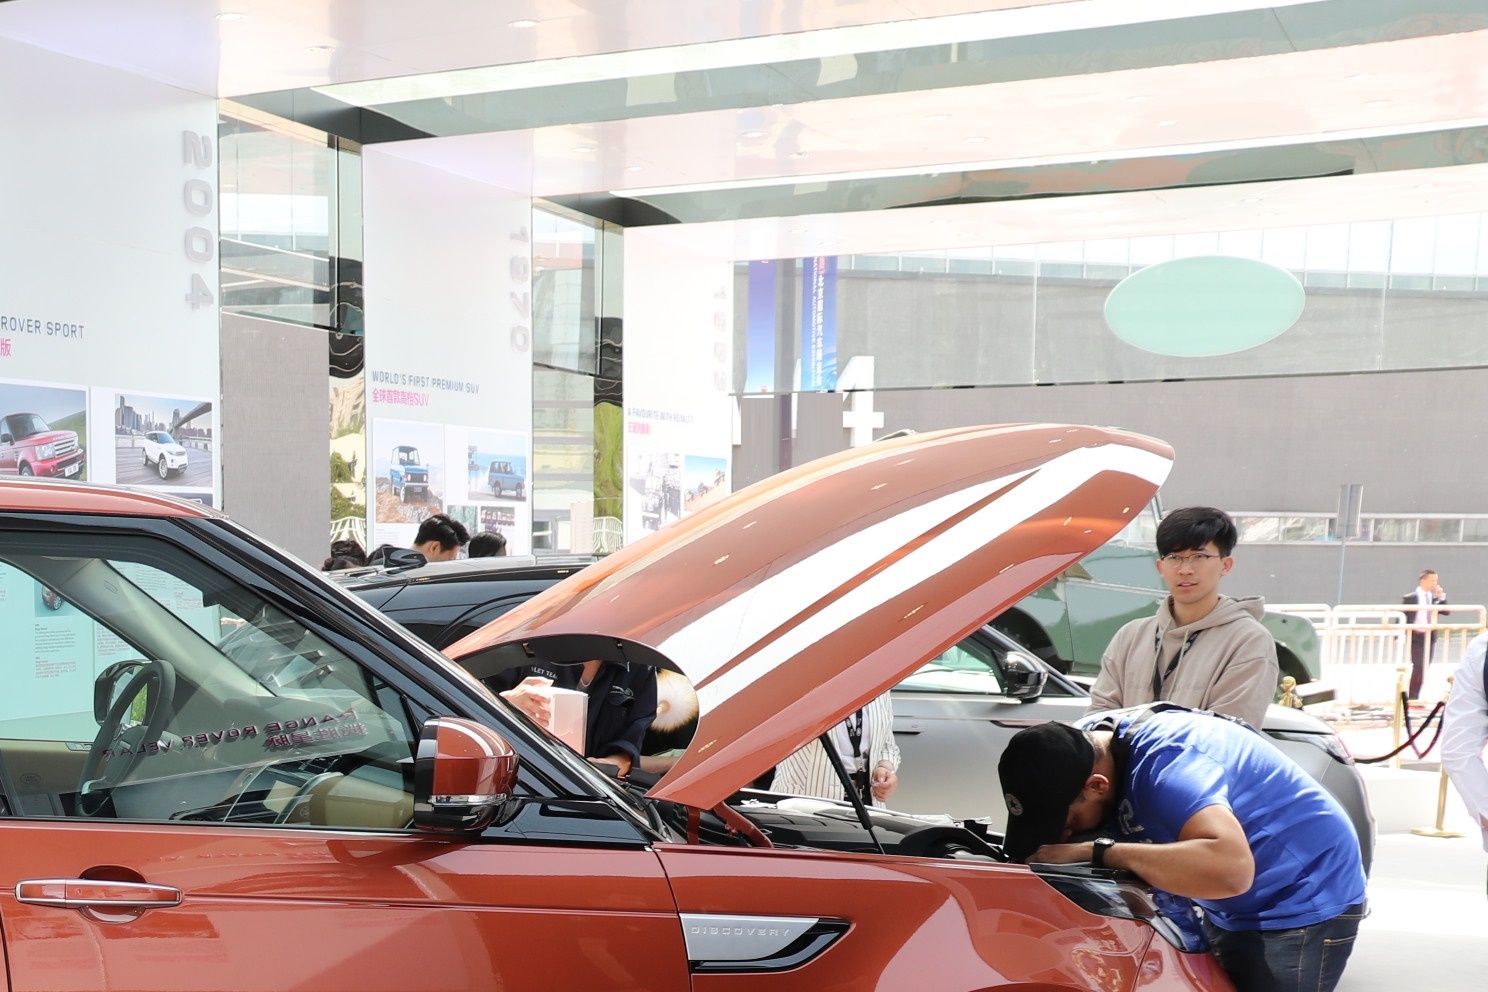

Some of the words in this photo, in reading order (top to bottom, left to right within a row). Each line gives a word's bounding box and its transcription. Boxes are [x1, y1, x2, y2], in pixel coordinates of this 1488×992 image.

[183, 130, 215, 310] 2004
[510, 225, 531, 354] 1970
[0, 315, 42, 335] ROVER
[46, 321, 85, 340] SPORT
[372, 369, 407, 386] WORLD'S
[408, 374, 430, 388] FIRST
[431, 377, 464, 392] PREMIUM
[466, 382, 480, 394] SUV
[690, 926, 791, 937] DISCOVERY
